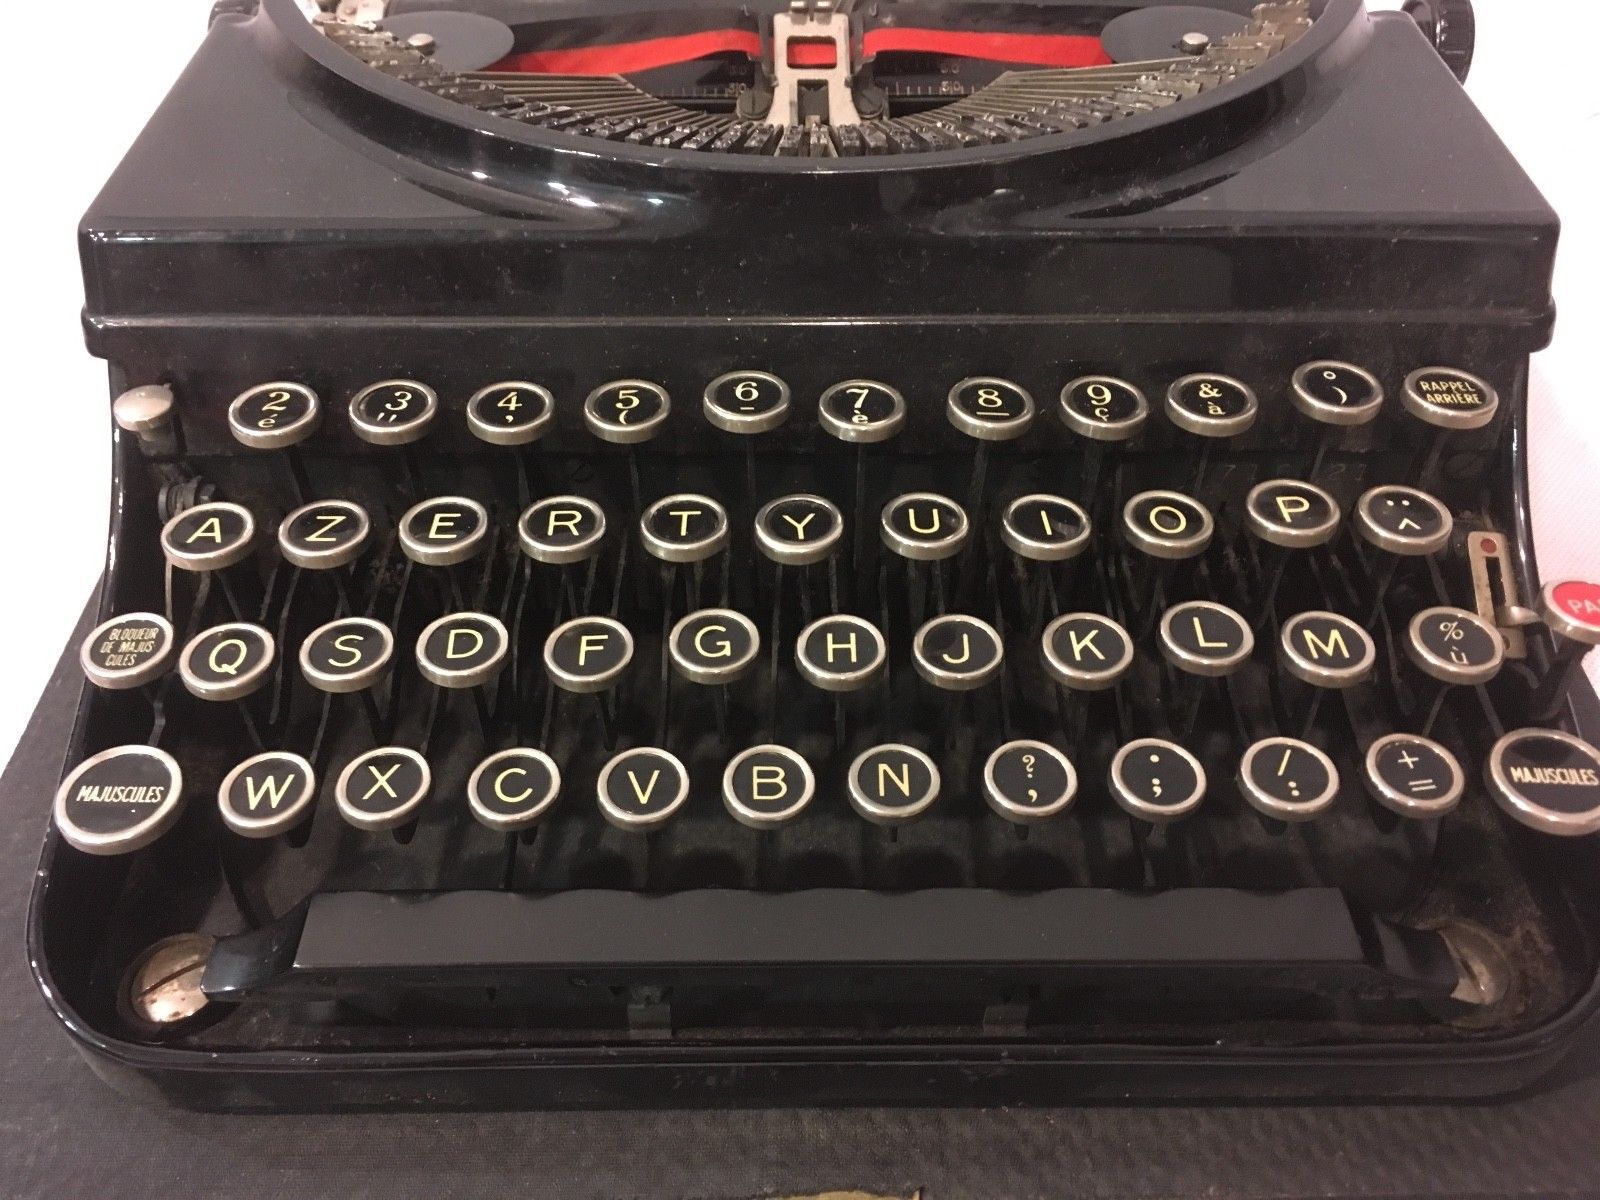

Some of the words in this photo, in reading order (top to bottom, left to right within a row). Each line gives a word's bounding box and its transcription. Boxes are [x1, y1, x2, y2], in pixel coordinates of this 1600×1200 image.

[735, 381, 759, 402] 6
[845, 388, 869, 409] 7
[977, 388, 1003, 408] 8
[1086, 384, 1112, 406] 9
[1198, 383, 1223, 399] &
[1419, 380, 1476, 392] RAPPEL
[261, 391, 291, 412] 2
[384, 390, 413, 411] 3
[497, 391, 523, 412] 4
[615, 389, 640, 410] 5
[1207, 401, 1226, 415] à
[257, 413, 277, 429] é
[908, 508, 940, 534] U
[1149, 505, 1187, 534] O
[1275, 496, 1310, 523] P
[185, 517, 222, 544] A
[304, 515, 347, 542] Z
[428, 513, 462, 539] E
[547, 510, 583, 537] R
[669, 510, 702, 537] T
[782, 513, 816, 540] Y
[1040, 510, 1053, 536] I
[1567, 598, 1600, 614] PA
[108, 627, 159, 641] BLOQUEUR
[446, 628, 484, 659] D
[694, 625, 732, 658] G
[1192, 616, 1228, 648] L
[1302, 628, 1350, 659] M
[1439, 621, 1464, 642] %
[100, 641, 115, 654] DE
[118, 640, 155, 653] MAJUS
[208, 638, 248, 676] Q
[328, 634, 364, 668] S
[578, 634, 609, 666] F
[826, 632, 857, 663] H
[942, 633, 970, 664] J
[1069, 629, 1106, 661] K
[104, 653, 137, 667] CULES
[1022, 754, 1036, 779] ?
[1509, 765, 1599, 786] MAJUSCULES
[245, 773, 295, 811] W
[362, 763, 401, 800] X
[494, 767, 533, 803] C
[627, 769, 660, 805] V
[752, 765, 788, 800] B
[878, 763, 910, 797] N
[76, 785, 164, 803] MAJUSCULES
